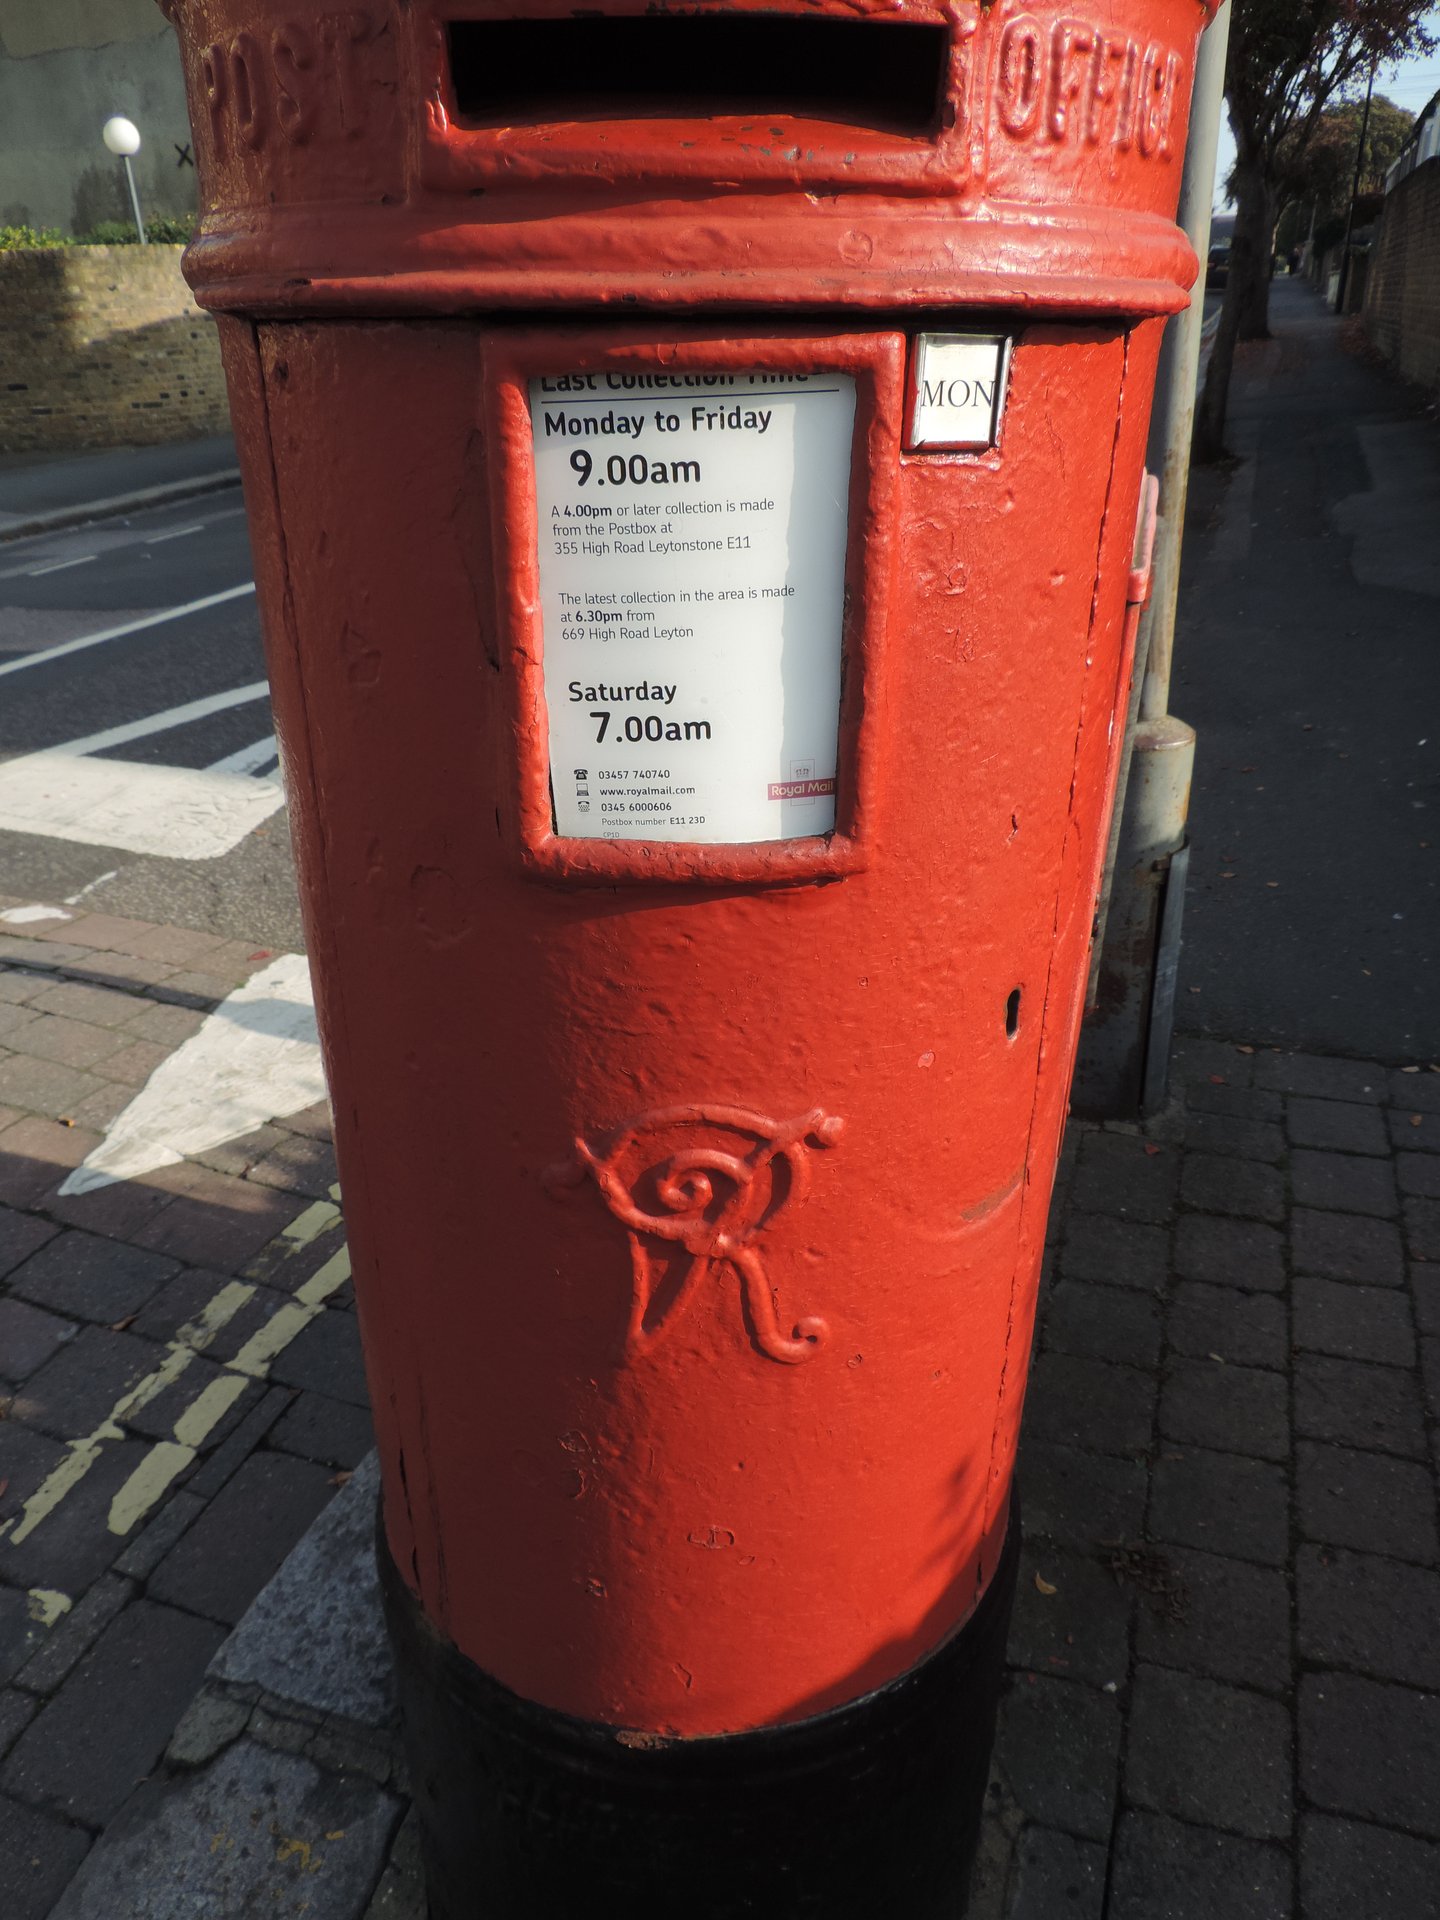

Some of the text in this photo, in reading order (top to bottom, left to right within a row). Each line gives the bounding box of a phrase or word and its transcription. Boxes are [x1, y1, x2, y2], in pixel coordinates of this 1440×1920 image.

[200, 12, 391, 164] POST
[921, 379, 995, 408] MON
[544, 405, 772, 439] Monday to Friday
[570, 449, 701, 487] 9.00am
[551, 498, 775, 519] A 4.00pm or later collection is made
[553, 522, 673, 536] from the Postbox at
[554, 536, 751, 556] 355 High Road Leytonstone E11
[558, 584, 795, 605] The latest collection in the area is made
[560, 609, 655, 624] at 6.30pm from
[562, 626, 694, 642] 669 High Road Leyton
[568, 680, 677, 705] Saturday
[589, 711, 712, 744] 7.00am
[598, 769, 671, 780] 03457 740740
[599, 786, 696, 797] www.royalmail.com
[771, 780, 833, 797] Royal Mail
[601, 802, 672, 812] 0345 6000606
[601, 818, 633, 826] Postbox
[635, 817, 666, 826] number
[669, 817, 686, 825] E11
